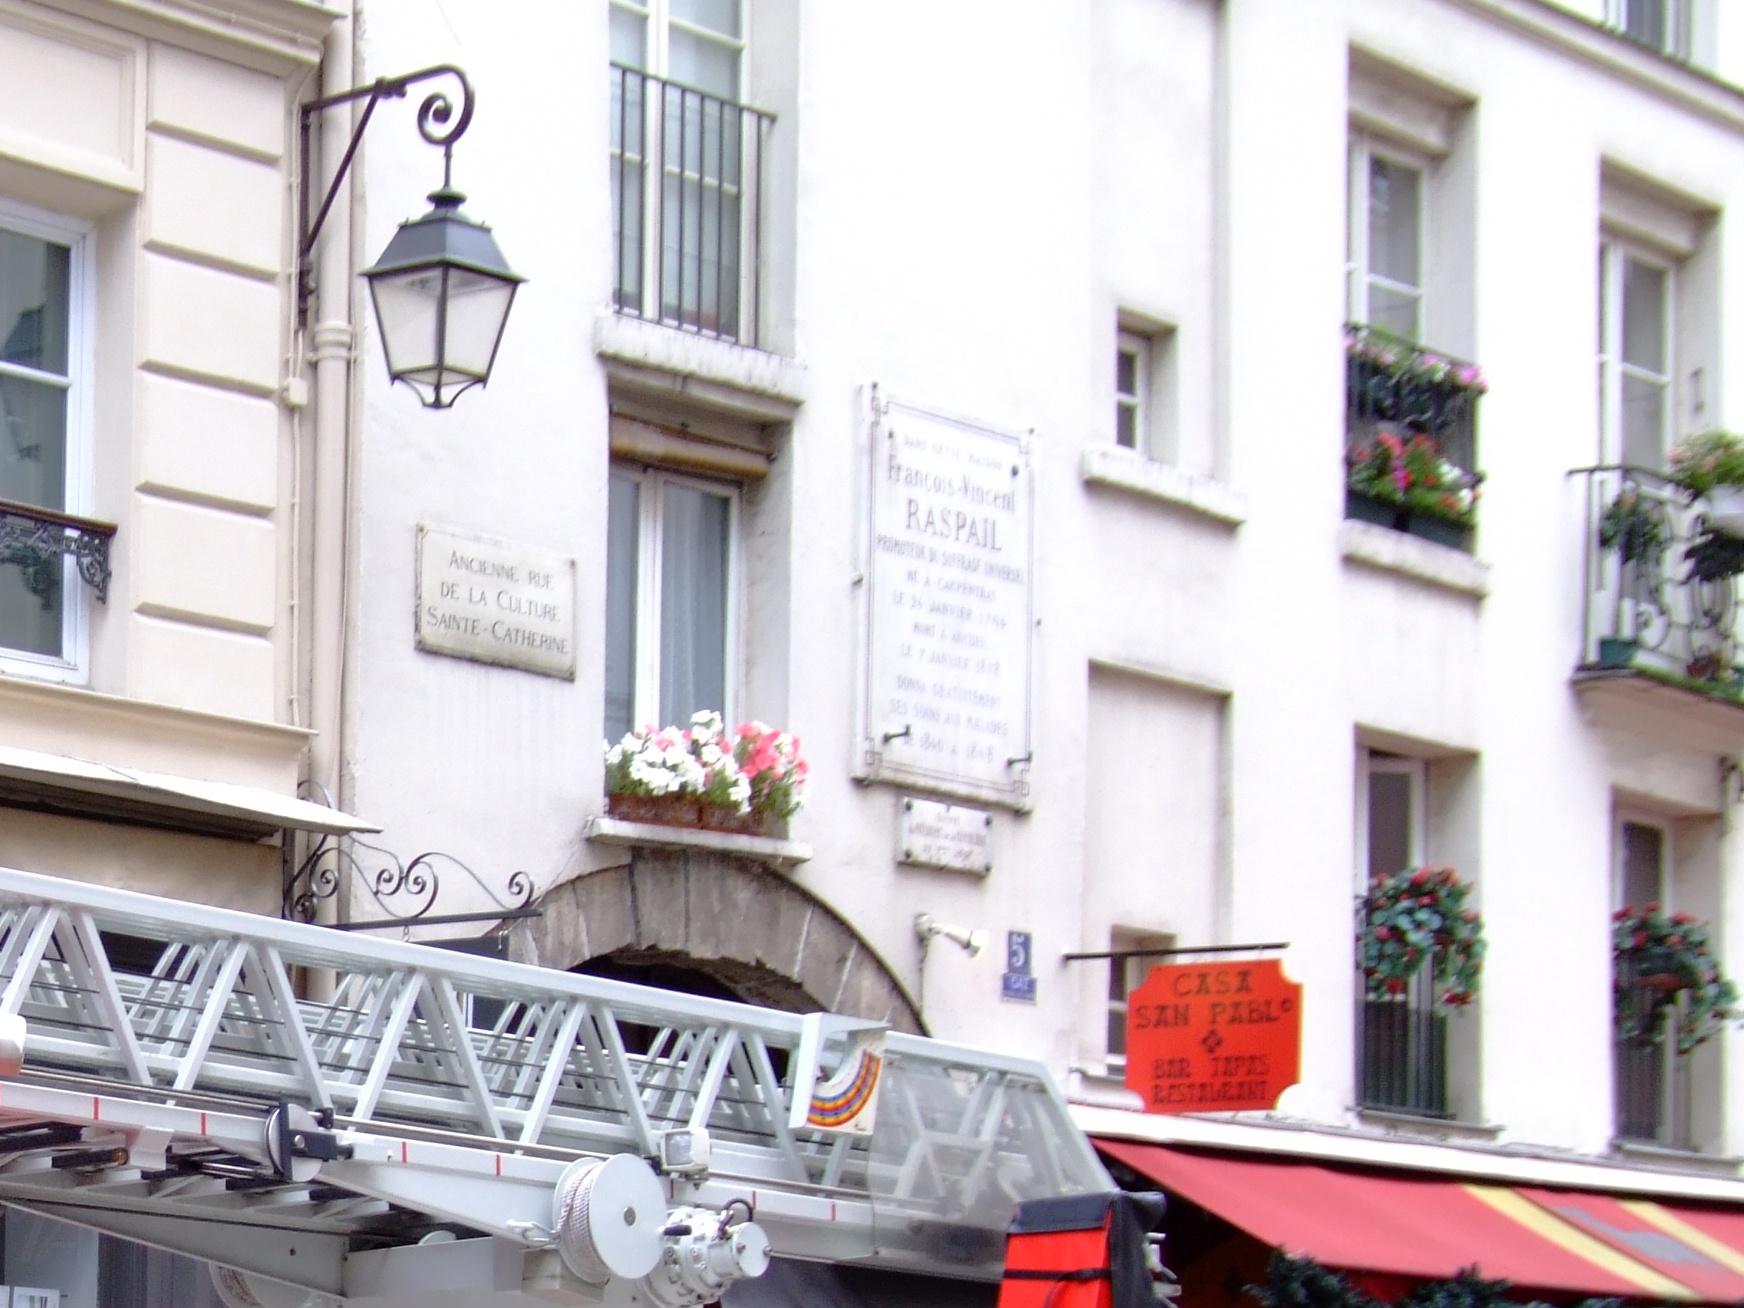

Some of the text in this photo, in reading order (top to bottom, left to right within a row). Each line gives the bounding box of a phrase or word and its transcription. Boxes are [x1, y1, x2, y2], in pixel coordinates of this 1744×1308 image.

[906, 498, 1003, 552] RASPAIL
[449, 550, 553, 590] ANCIENNE RUE
[440, 581, 560, 623] DE LA CULTURE
[1012, 933, 1025, 967] 5
[1173, 970, 1253, 997] CASA
[1135, 1003, 1190, 1029] SAN
[1153, 1053, 1270, 1079] BAR TAPAS
[1152, 1080, 1268, 1104] RESTAURANT
